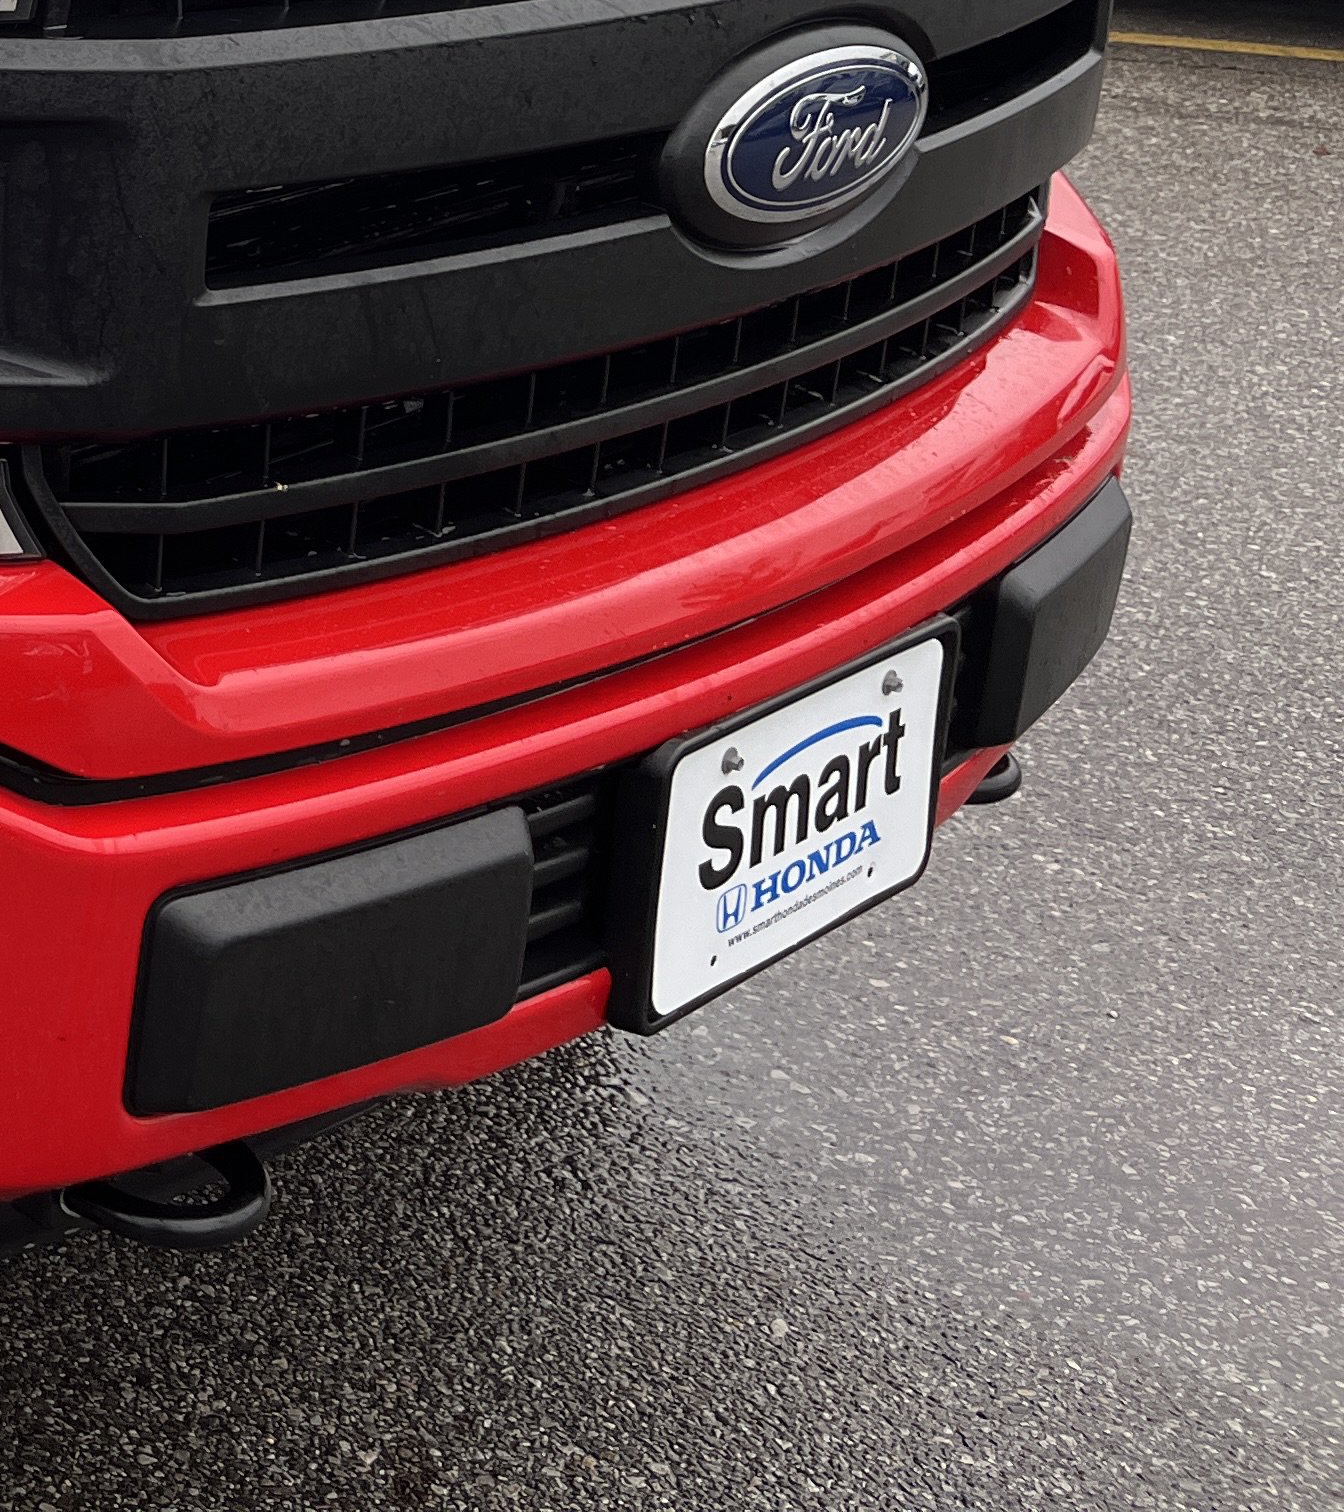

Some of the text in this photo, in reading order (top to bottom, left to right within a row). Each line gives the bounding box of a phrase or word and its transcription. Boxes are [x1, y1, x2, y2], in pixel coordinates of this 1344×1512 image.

[772, 85, 892, 192] Ford
[698, 708, 906, 891] Smart
[750, 819, 881, 912] HONDA
